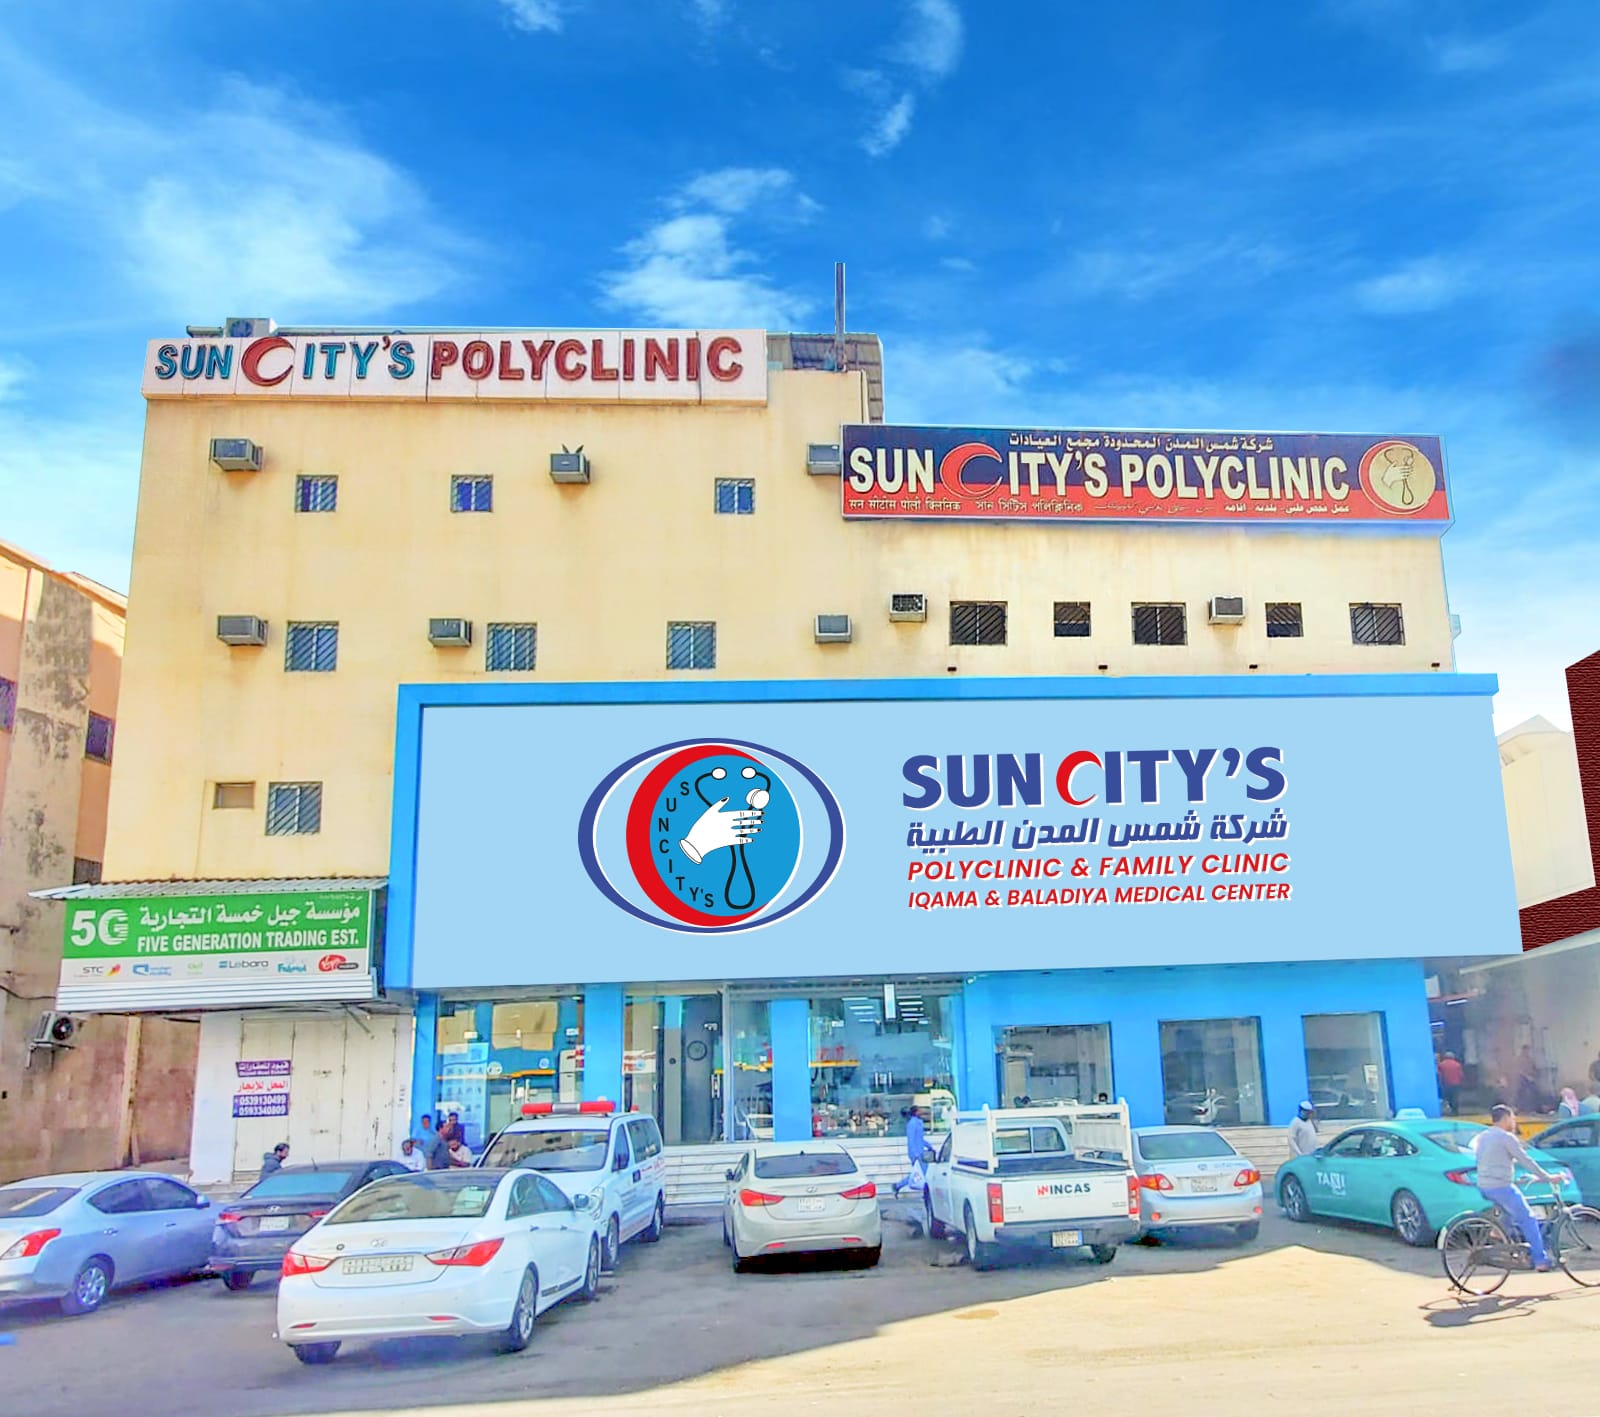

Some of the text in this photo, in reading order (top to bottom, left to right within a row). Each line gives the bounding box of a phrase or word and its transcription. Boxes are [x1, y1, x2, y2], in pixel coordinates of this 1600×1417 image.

[155, 342, 232, 380] SUN
[430, 336, 744, 382] POLYCLINIC
[1010, 433, 1061, 449] العيادات
[1066, 436, 1100, 451] مجمع
[1165, 437, 1204, 452] المدن
[1205, 436, 1239, 453] شمس
[1241, 436, 1273, 453] شركة
[850, 447, 934, 494] SUN
[1121, 453, 1350, 500] POLYCLINIC
[902, 752, 1042, 809] SUN
[907, 807, 1289, 855] شركة شمس المدن الطبية
[907, 852, 1291, 882] POLYCLINIC & FAMILY CLINIC
[908, 882, 1291, 911] IQAMA & BALADIYA MEDICAL CENTER
[71, 909, 128, 946] 5G
[138, 900, 360, 932] مؤسسة جيل خمسة التجارية
[137, 928, 359, 952] FIVE GENERATION TRADING EST.
[82, 966, 104, 974] STC
[1050, 1183, 1091, 1196] INCAS
